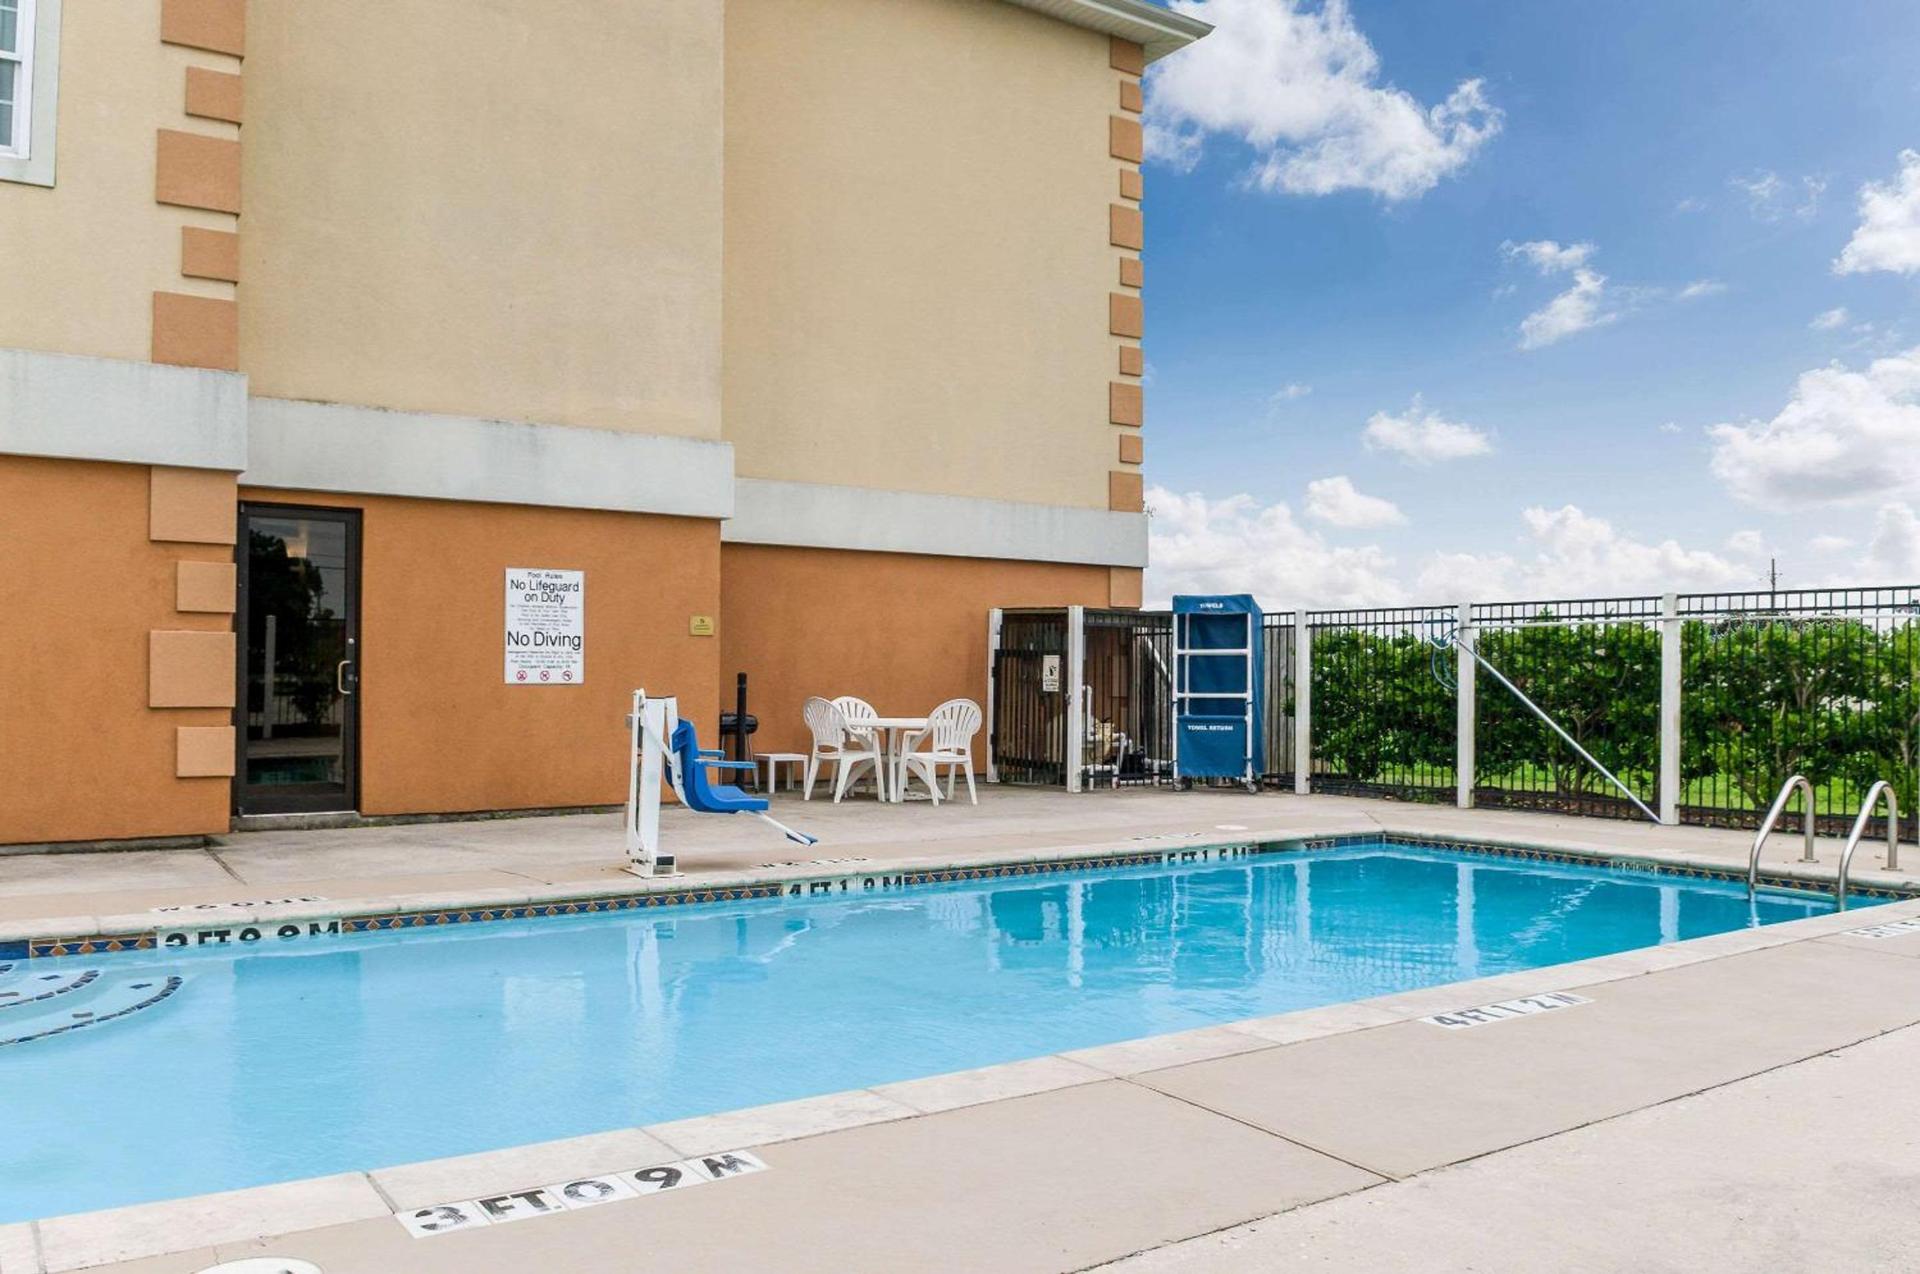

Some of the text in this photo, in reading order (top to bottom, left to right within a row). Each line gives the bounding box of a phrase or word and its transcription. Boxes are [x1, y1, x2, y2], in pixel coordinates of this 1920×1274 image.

[510, 579, 579, 593] No Lifeguard
[524, 592, 565, 605] on Duty
[508, 631, 581, 651] No Diving
